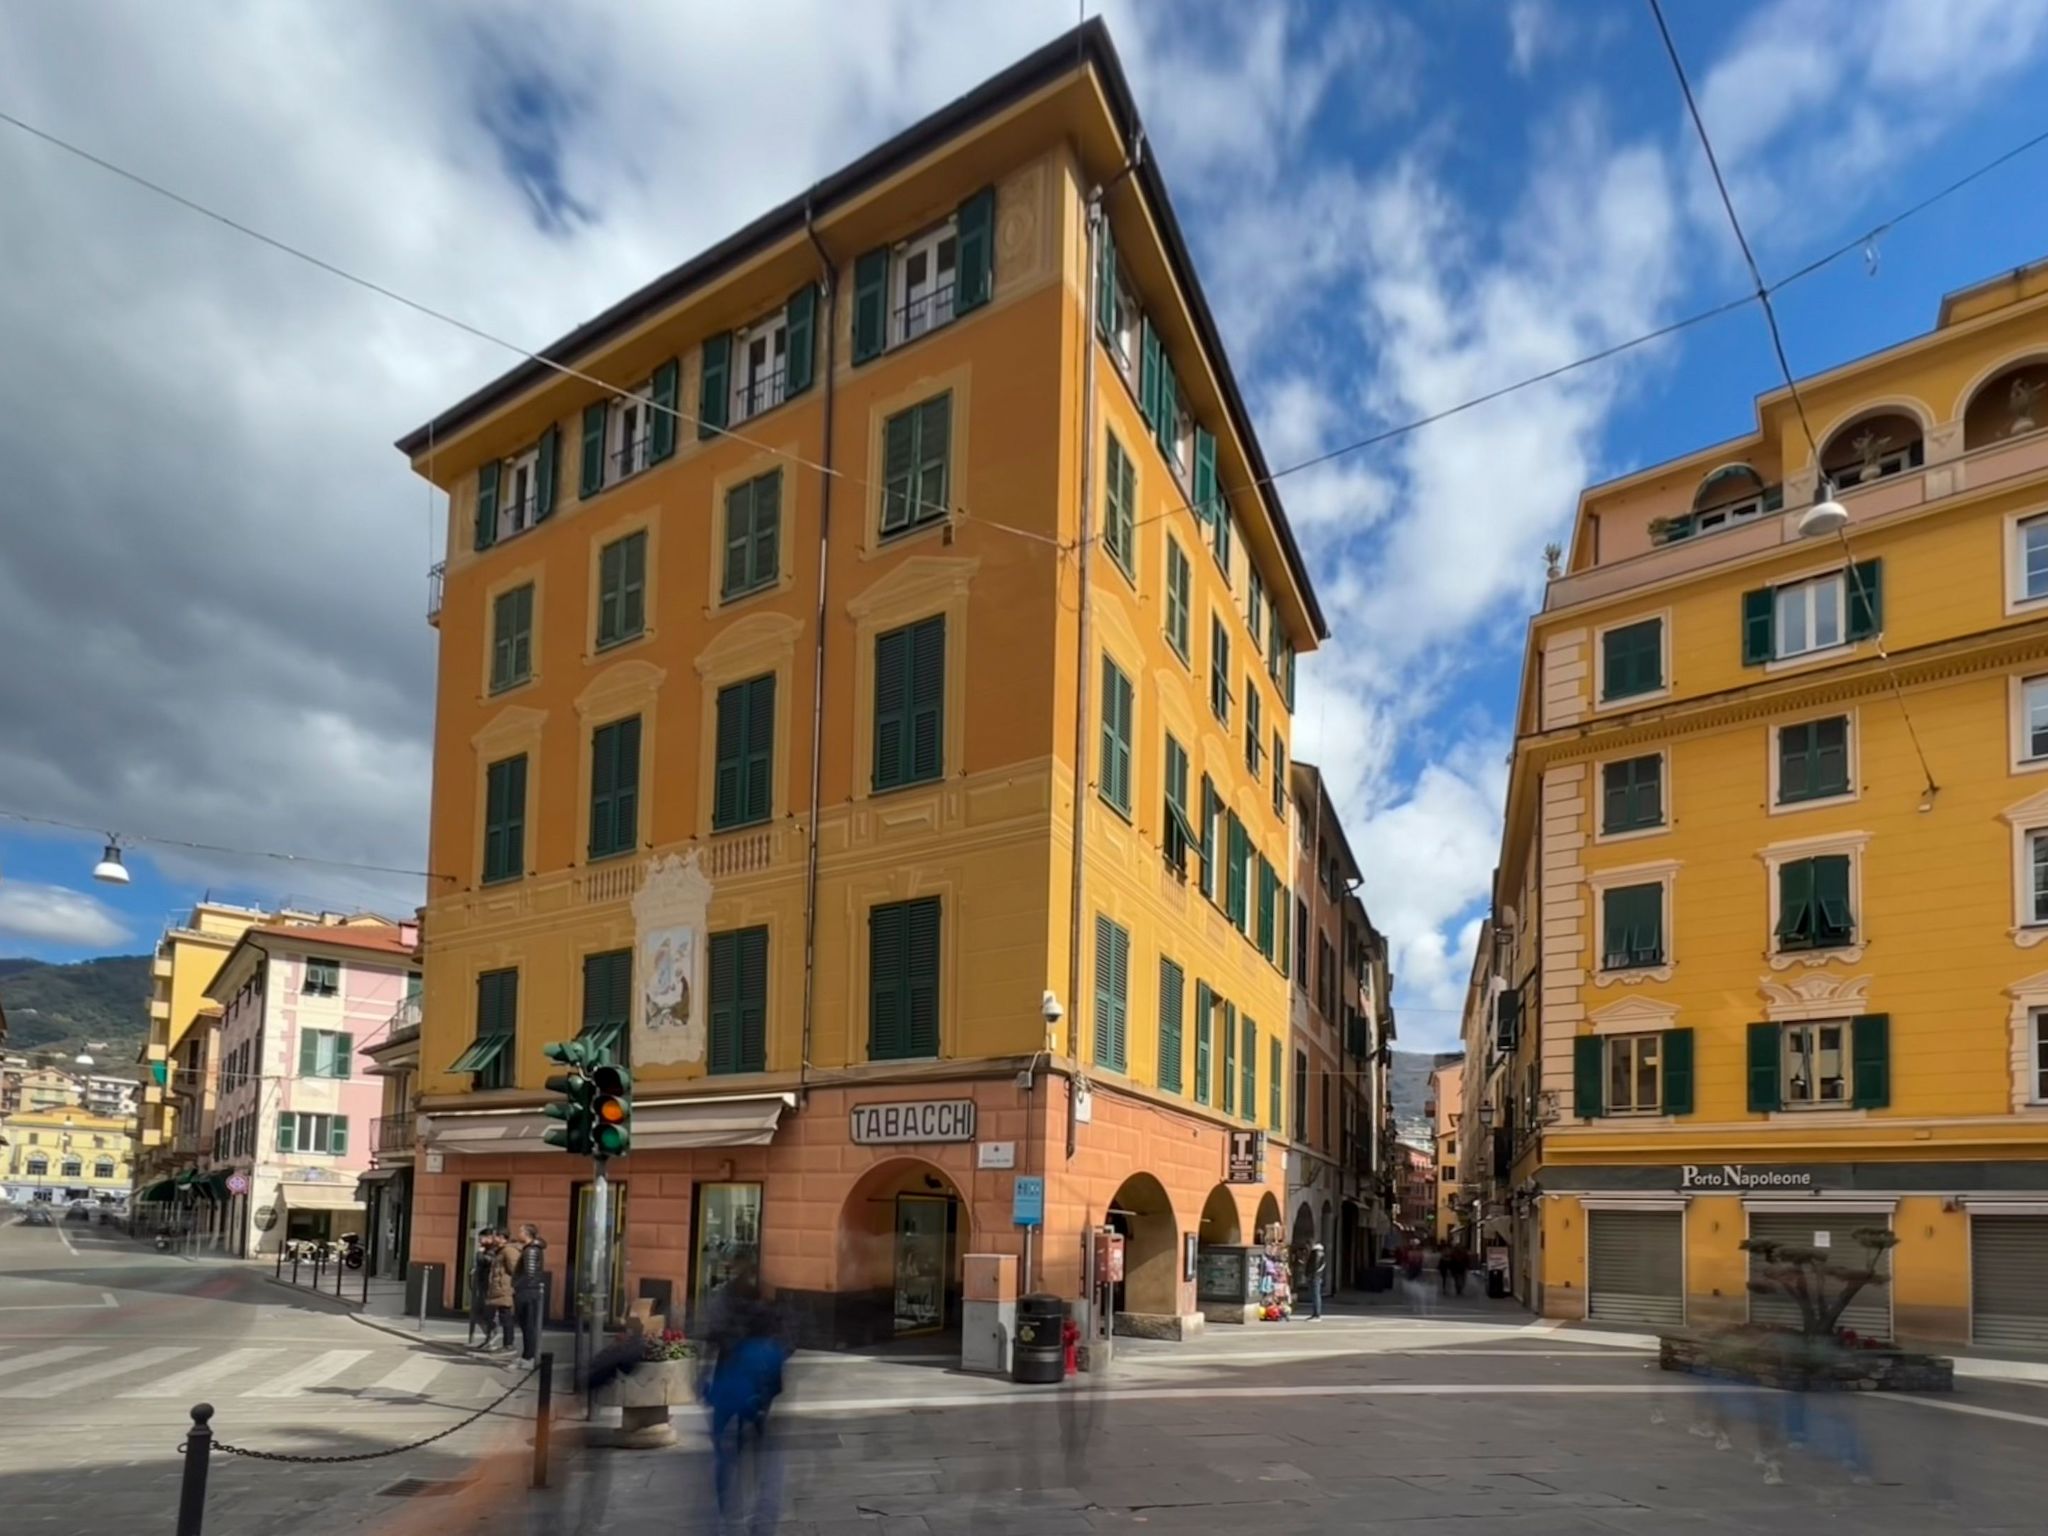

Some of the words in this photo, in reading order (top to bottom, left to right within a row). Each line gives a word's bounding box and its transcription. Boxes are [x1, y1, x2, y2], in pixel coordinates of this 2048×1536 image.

[853, 1104, 972, 1139] TABACCHI
[1233, 1132, 1251, 1161] T
[1681, 1164, 1722, 1187] Porto
[1723, 1164, 1811, 1188] Napoleone
